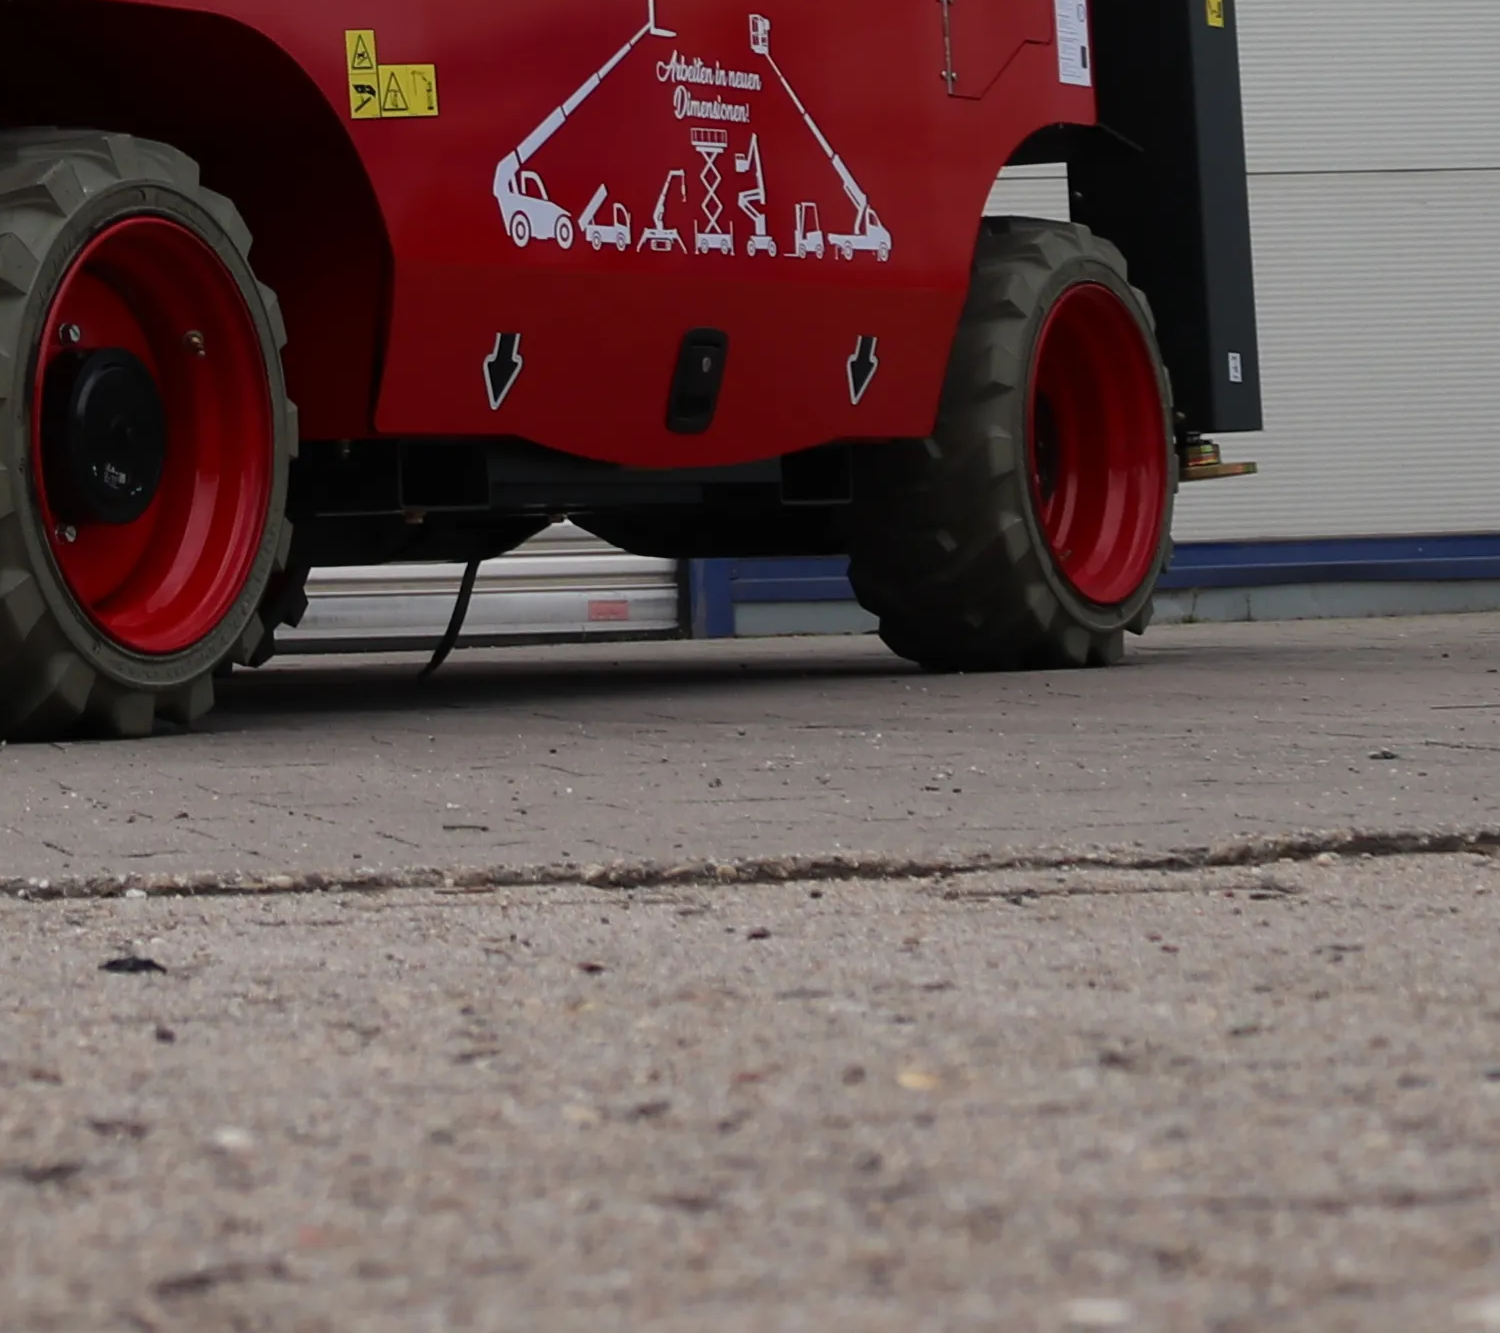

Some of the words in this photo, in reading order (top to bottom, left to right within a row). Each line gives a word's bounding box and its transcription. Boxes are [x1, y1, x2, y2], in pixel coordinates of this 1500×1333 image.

[656, 49, 714, 85] Arbeiten
[714, 60, 727, 87] in
[728, 70, 762, 91] neuen
[673, 84, 750, 123] Dimensionen!
